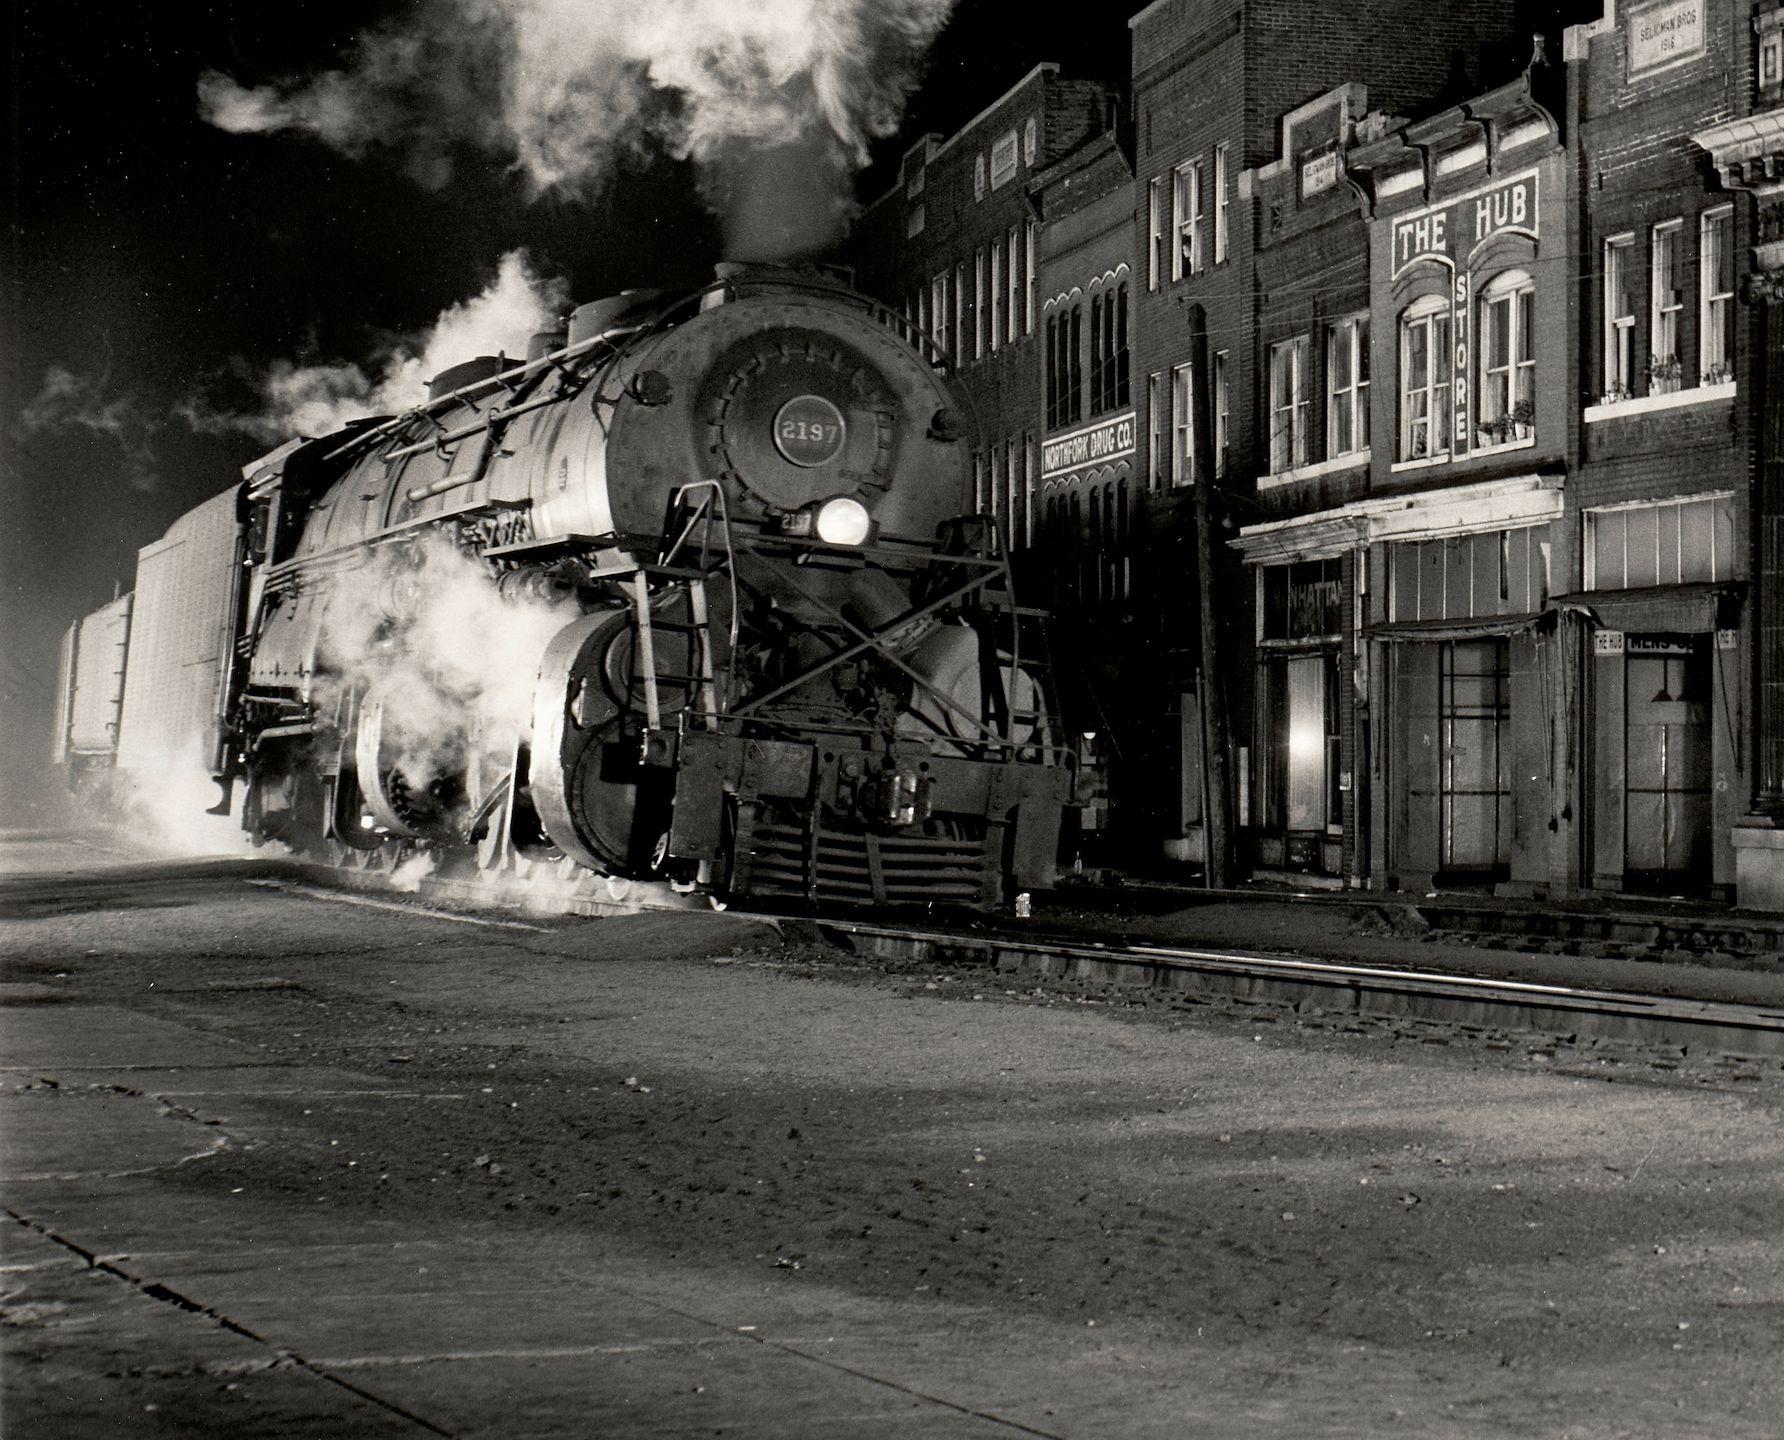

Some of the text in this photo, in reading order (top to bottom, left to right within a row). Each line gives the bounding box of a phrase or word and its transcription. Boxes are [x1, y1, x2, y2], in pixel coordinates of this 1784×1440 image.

[1677, 9, 1696, 29] BROS
[1399, 184, 1527, 260] THE HUB
[1455, 275, 1467, 441] STORE
[782, 420, 838, 444] 2197
[1045, 421, 1132, 471] NORTHFORK DRUG CO.
[1595, 633, 1623, 649] THE HUB
